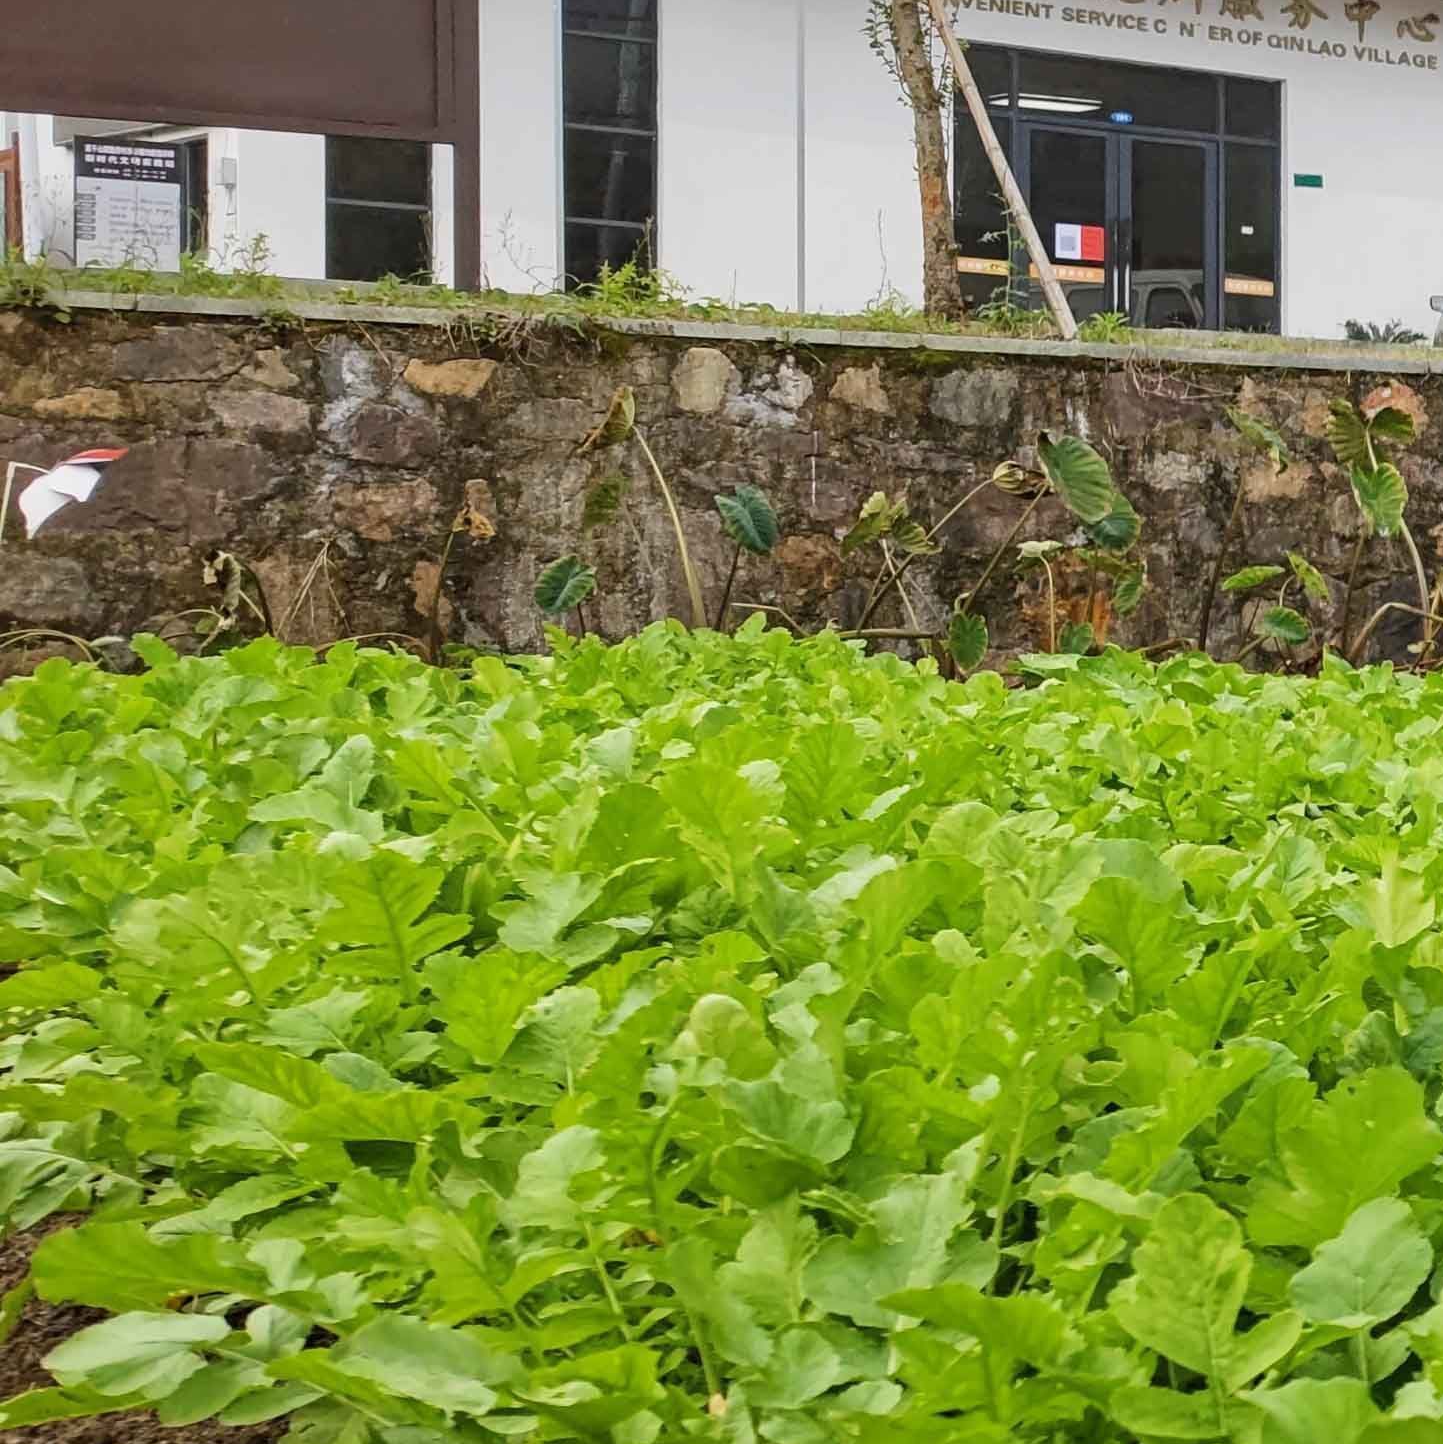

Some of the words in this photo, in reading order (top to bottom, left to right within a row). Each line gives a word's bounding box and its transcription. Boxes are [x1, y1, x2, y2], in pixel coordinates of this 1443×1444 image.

[1061, 7, 1148, 32] SERVICE
[1153, 18, 1234, 43] CNER
[1236, 28, 1263, 46] OF
[1353, 44, 1439, 70] VILLAGE
